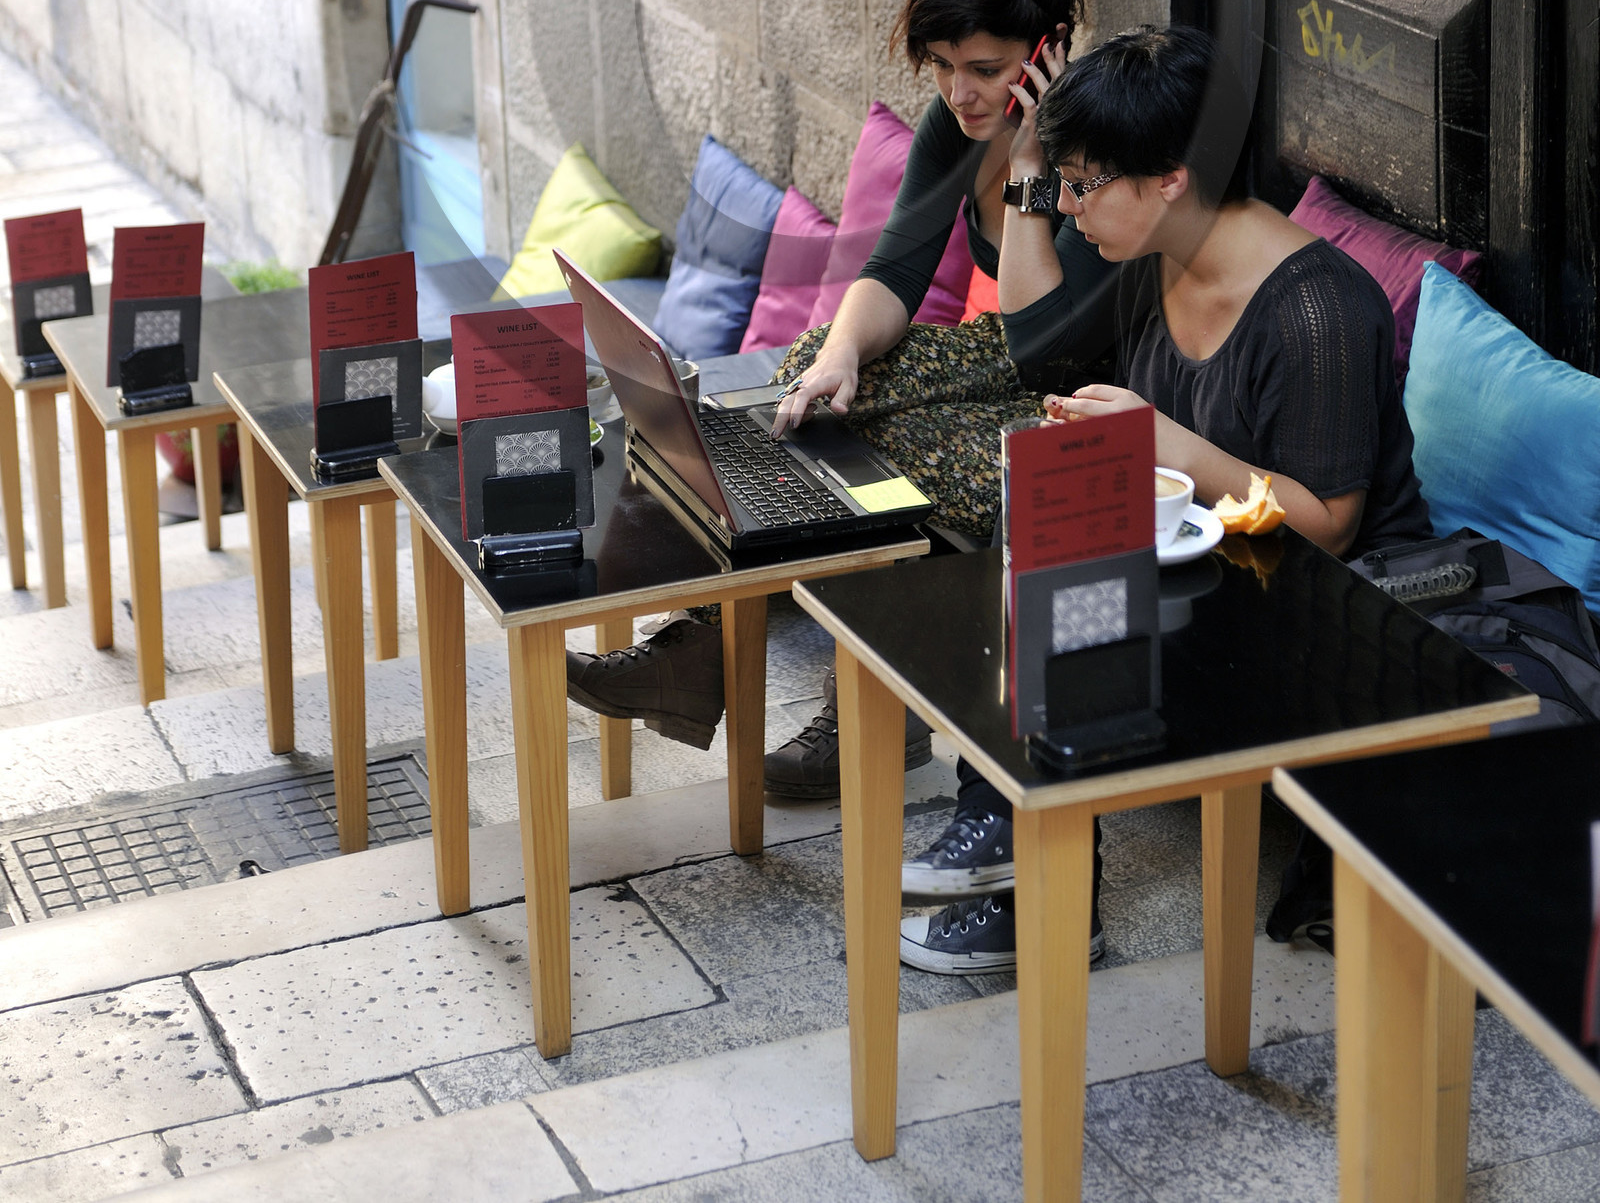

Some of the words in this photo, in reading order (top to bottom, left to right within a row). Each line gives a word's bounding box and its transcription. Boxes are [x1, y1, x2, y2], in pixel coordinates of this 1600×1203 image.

[346, 272, 365, 281] WINE
[366, 270, 380, 279] LIST
[497, 325, 520, 334] WINE
[522, 323, 538, 331] LIST
